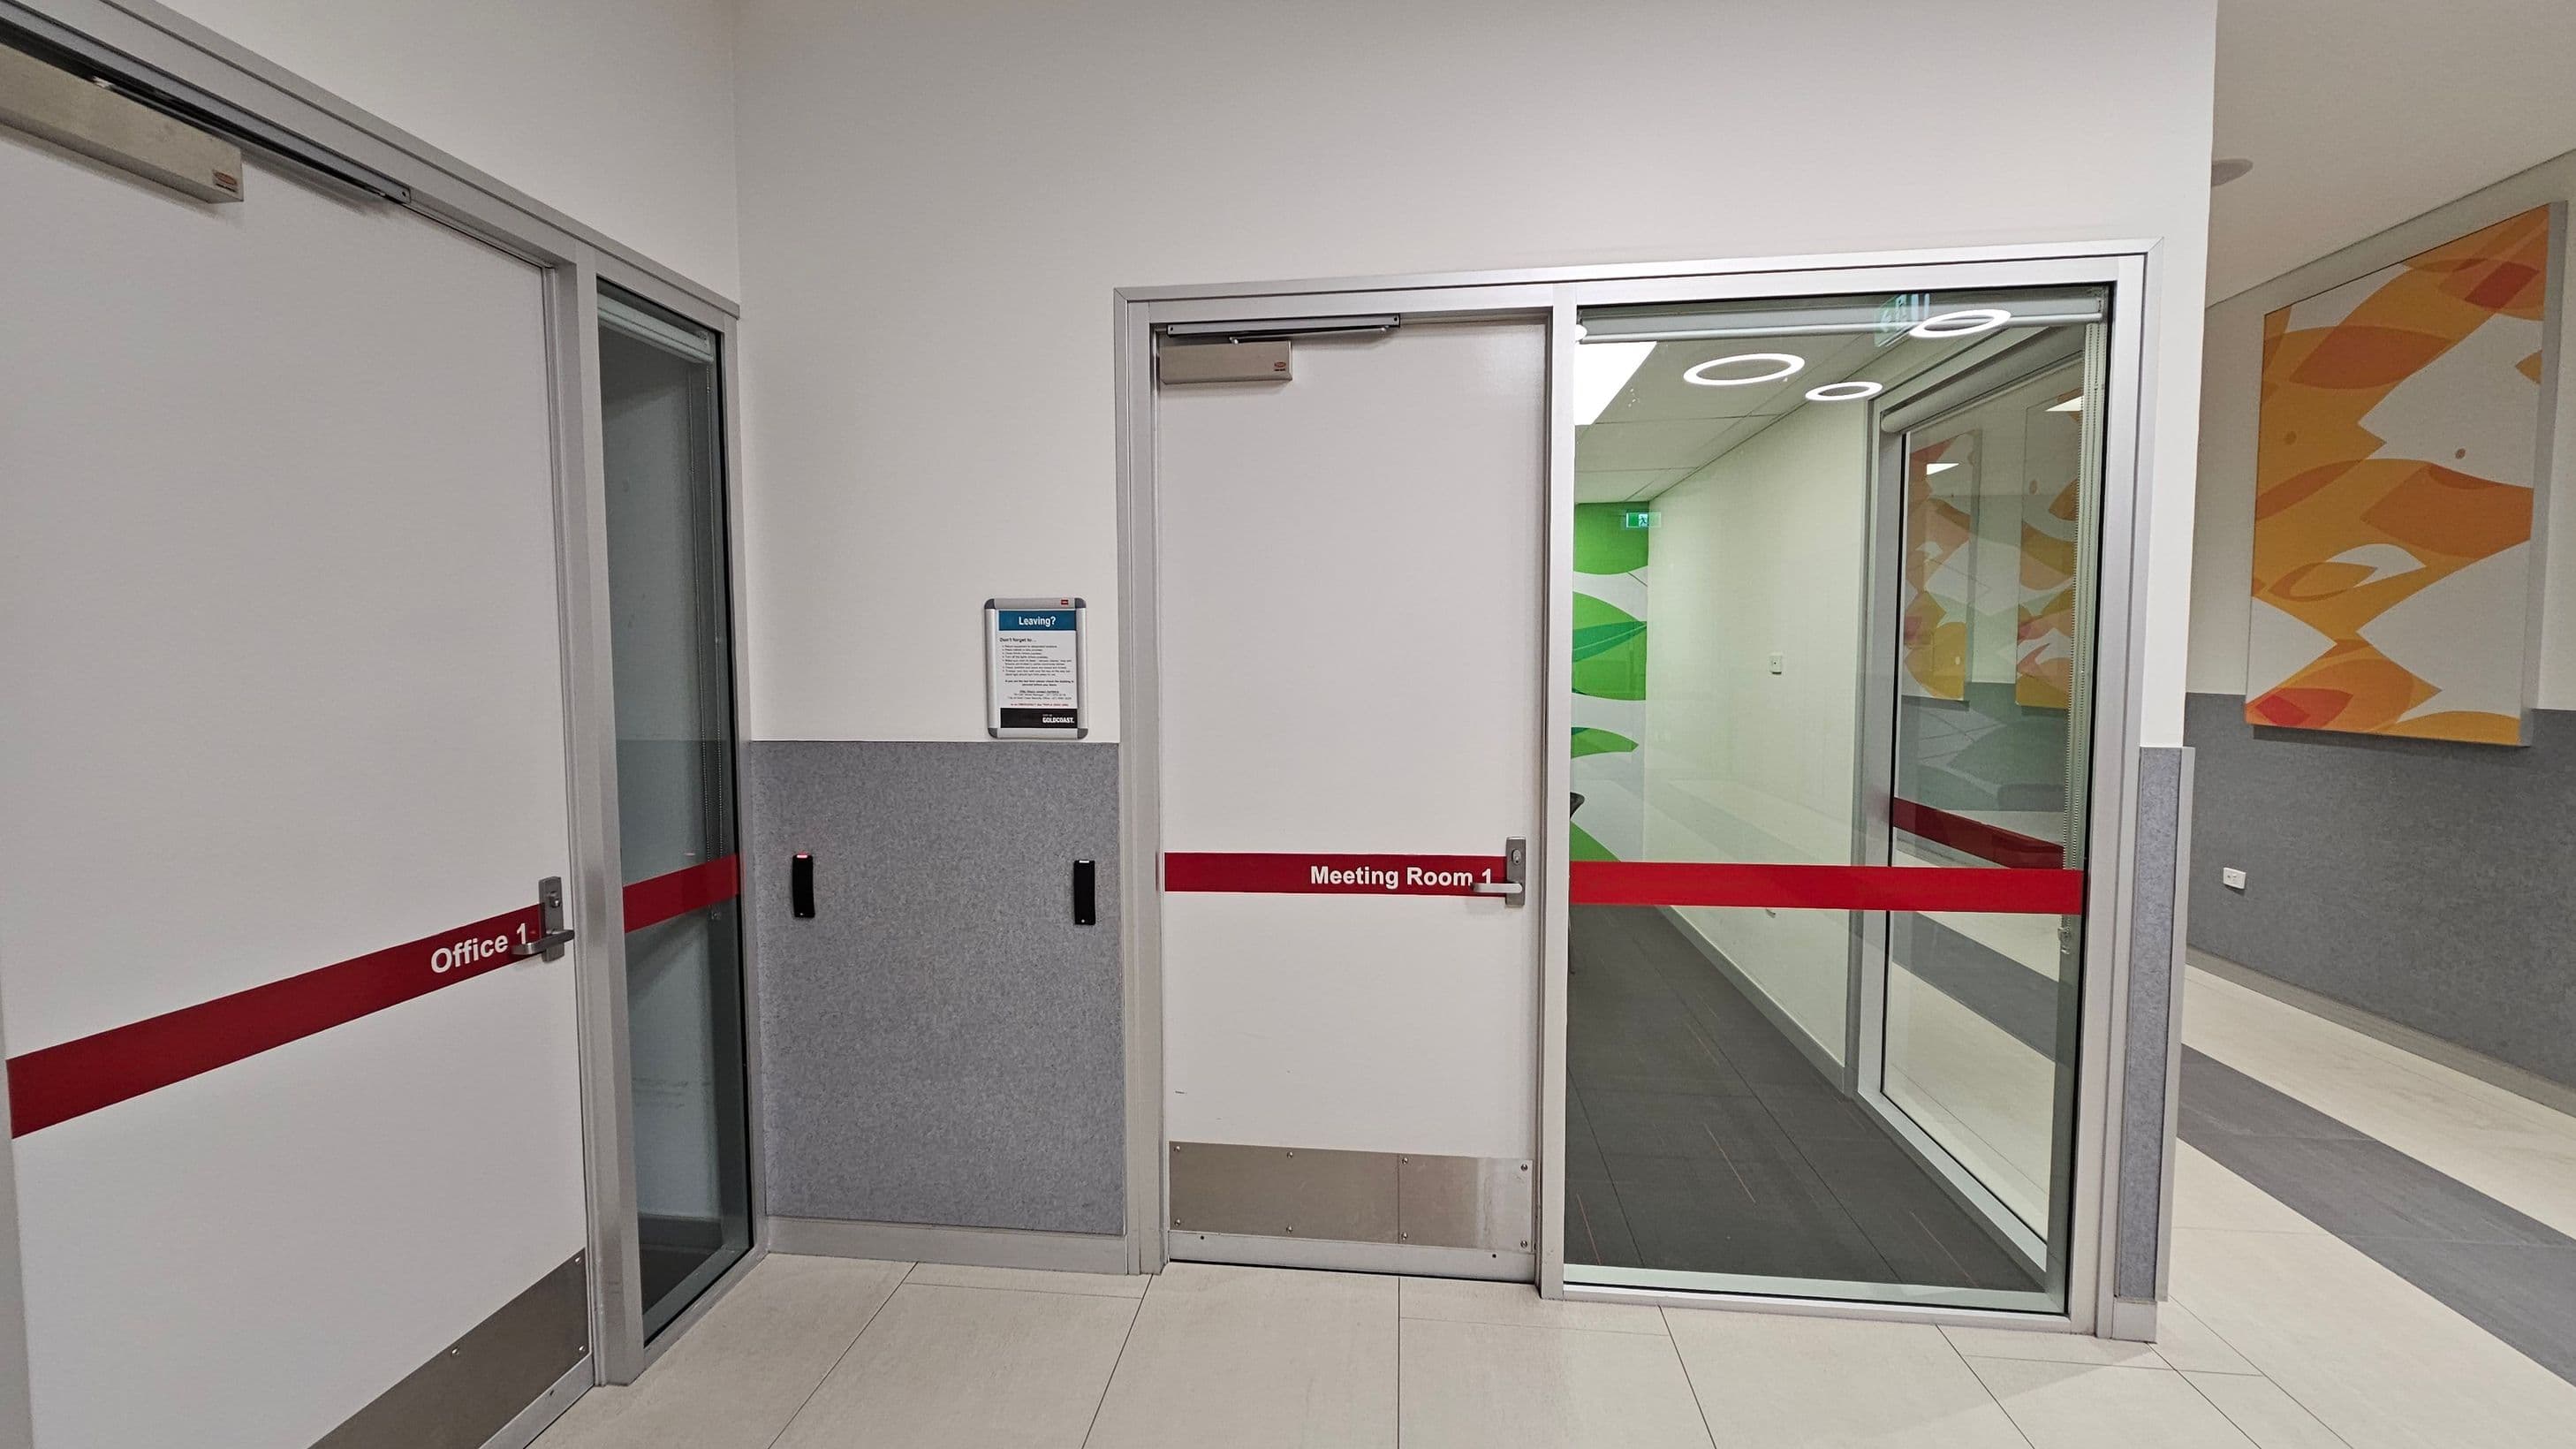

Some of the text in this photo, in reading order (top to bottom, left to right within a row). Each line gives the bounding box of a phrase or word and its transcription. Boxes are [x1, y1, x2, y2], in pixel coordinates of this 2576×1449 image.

[1019, 616, 1056, 627] Leaving?
[1310, 866, 1492, 889] Meeting Room 1
[430, 922, 527, 974] Office 1
